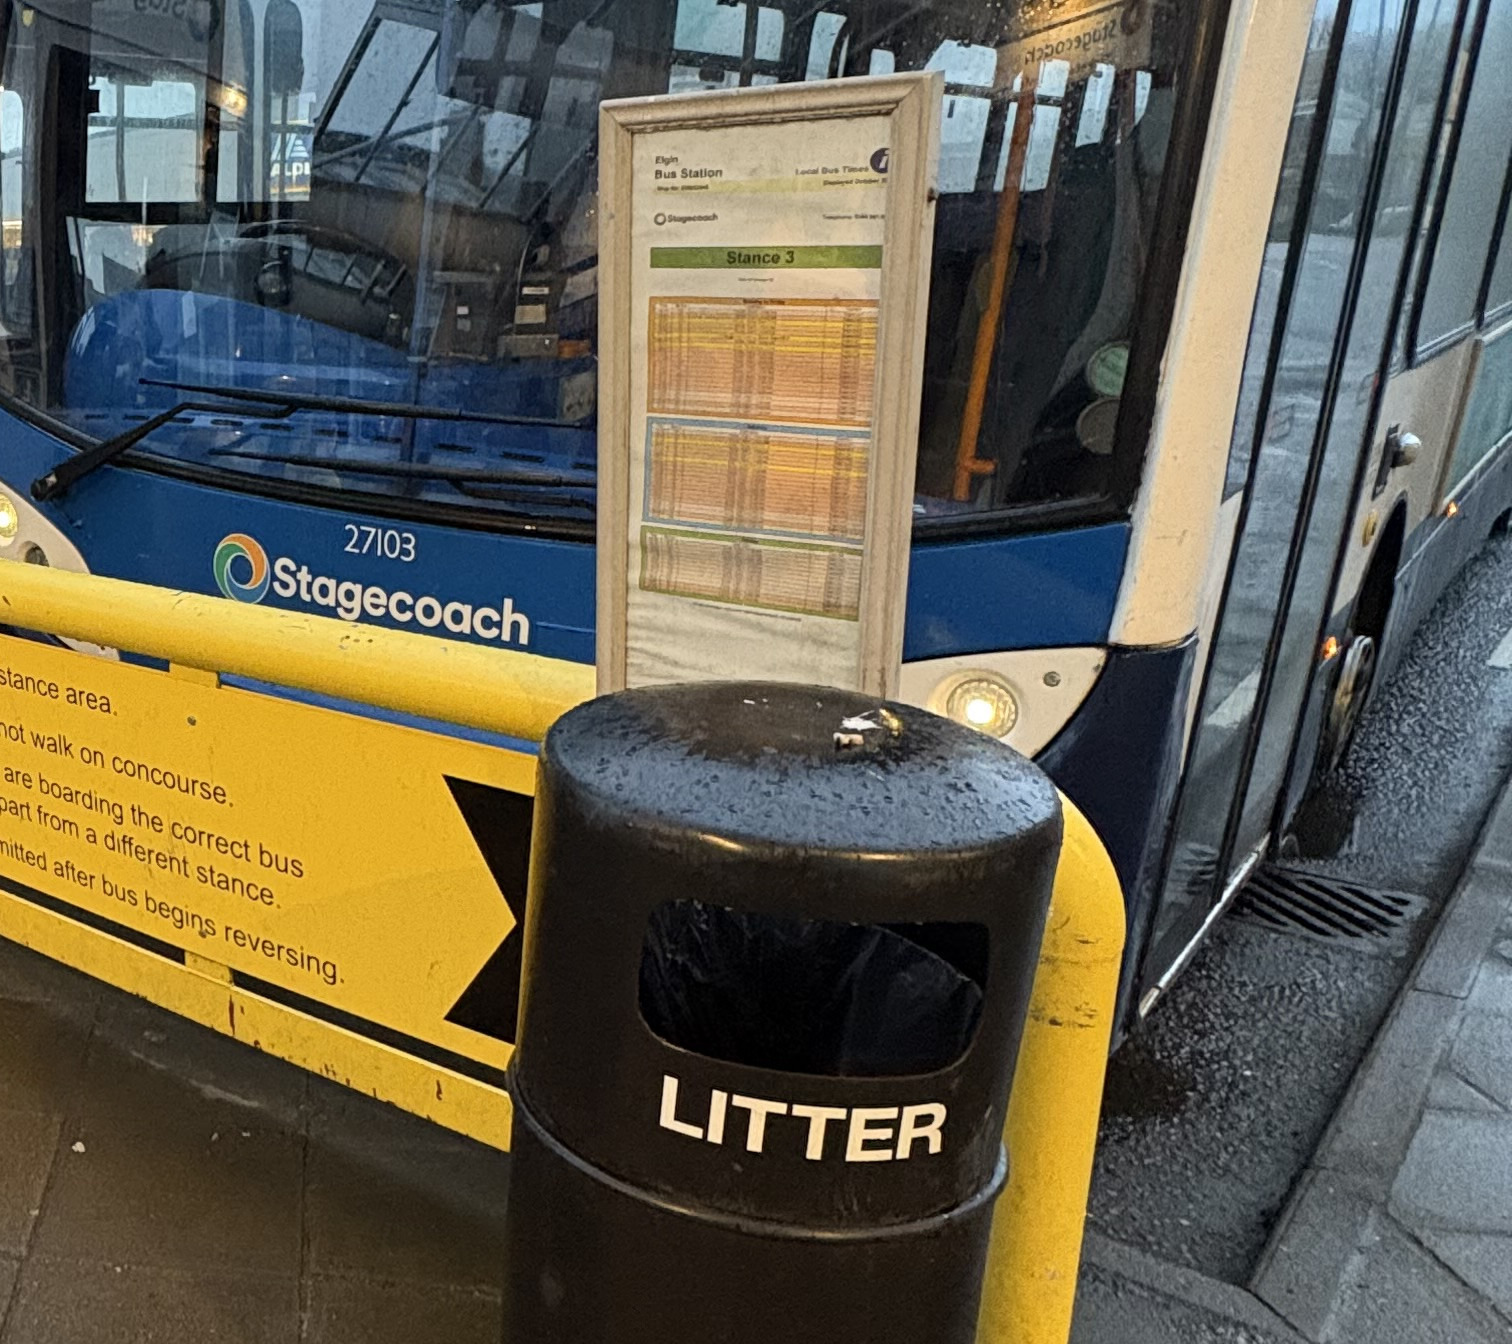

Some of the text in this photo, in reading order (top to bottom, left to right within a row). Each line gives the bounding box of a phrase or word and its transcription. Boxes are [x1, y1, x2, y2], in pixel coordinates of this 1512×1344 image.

[655, 156, 679, 166] Elgin
[655, 168, 723, 179] Bus Station
[726, 249, 795, 266] Stance 3
[344, 524, 418, 563] 27103
[273, 556, 529, 646] Stagecoach
[66, 687, 117, 716] area.
[30, 731, 74, 759] walk
[80, 747, 104, 768] on
[112, 756, 233, 807] concourse.
[4, 767, 32, 789] are
[39, 772, 123, 825] boarding
[130, 804, 163, 833] the
[171, 822, 251, 862] correct
[259, 843, 304, 878] bus
[37, 805, 79, 838] from
[86, 828, 97, 845] a
[104, 831, 189, 878] different
[197, 865, 280, 908] stance.
[54, 860, 95, 889] after
[102, 874, 138, 906] bus
[145, 890, 216, 939] begins
[225, 926, 344, 985] reversing.
[659, 1075, 947, 1163] LITTER
